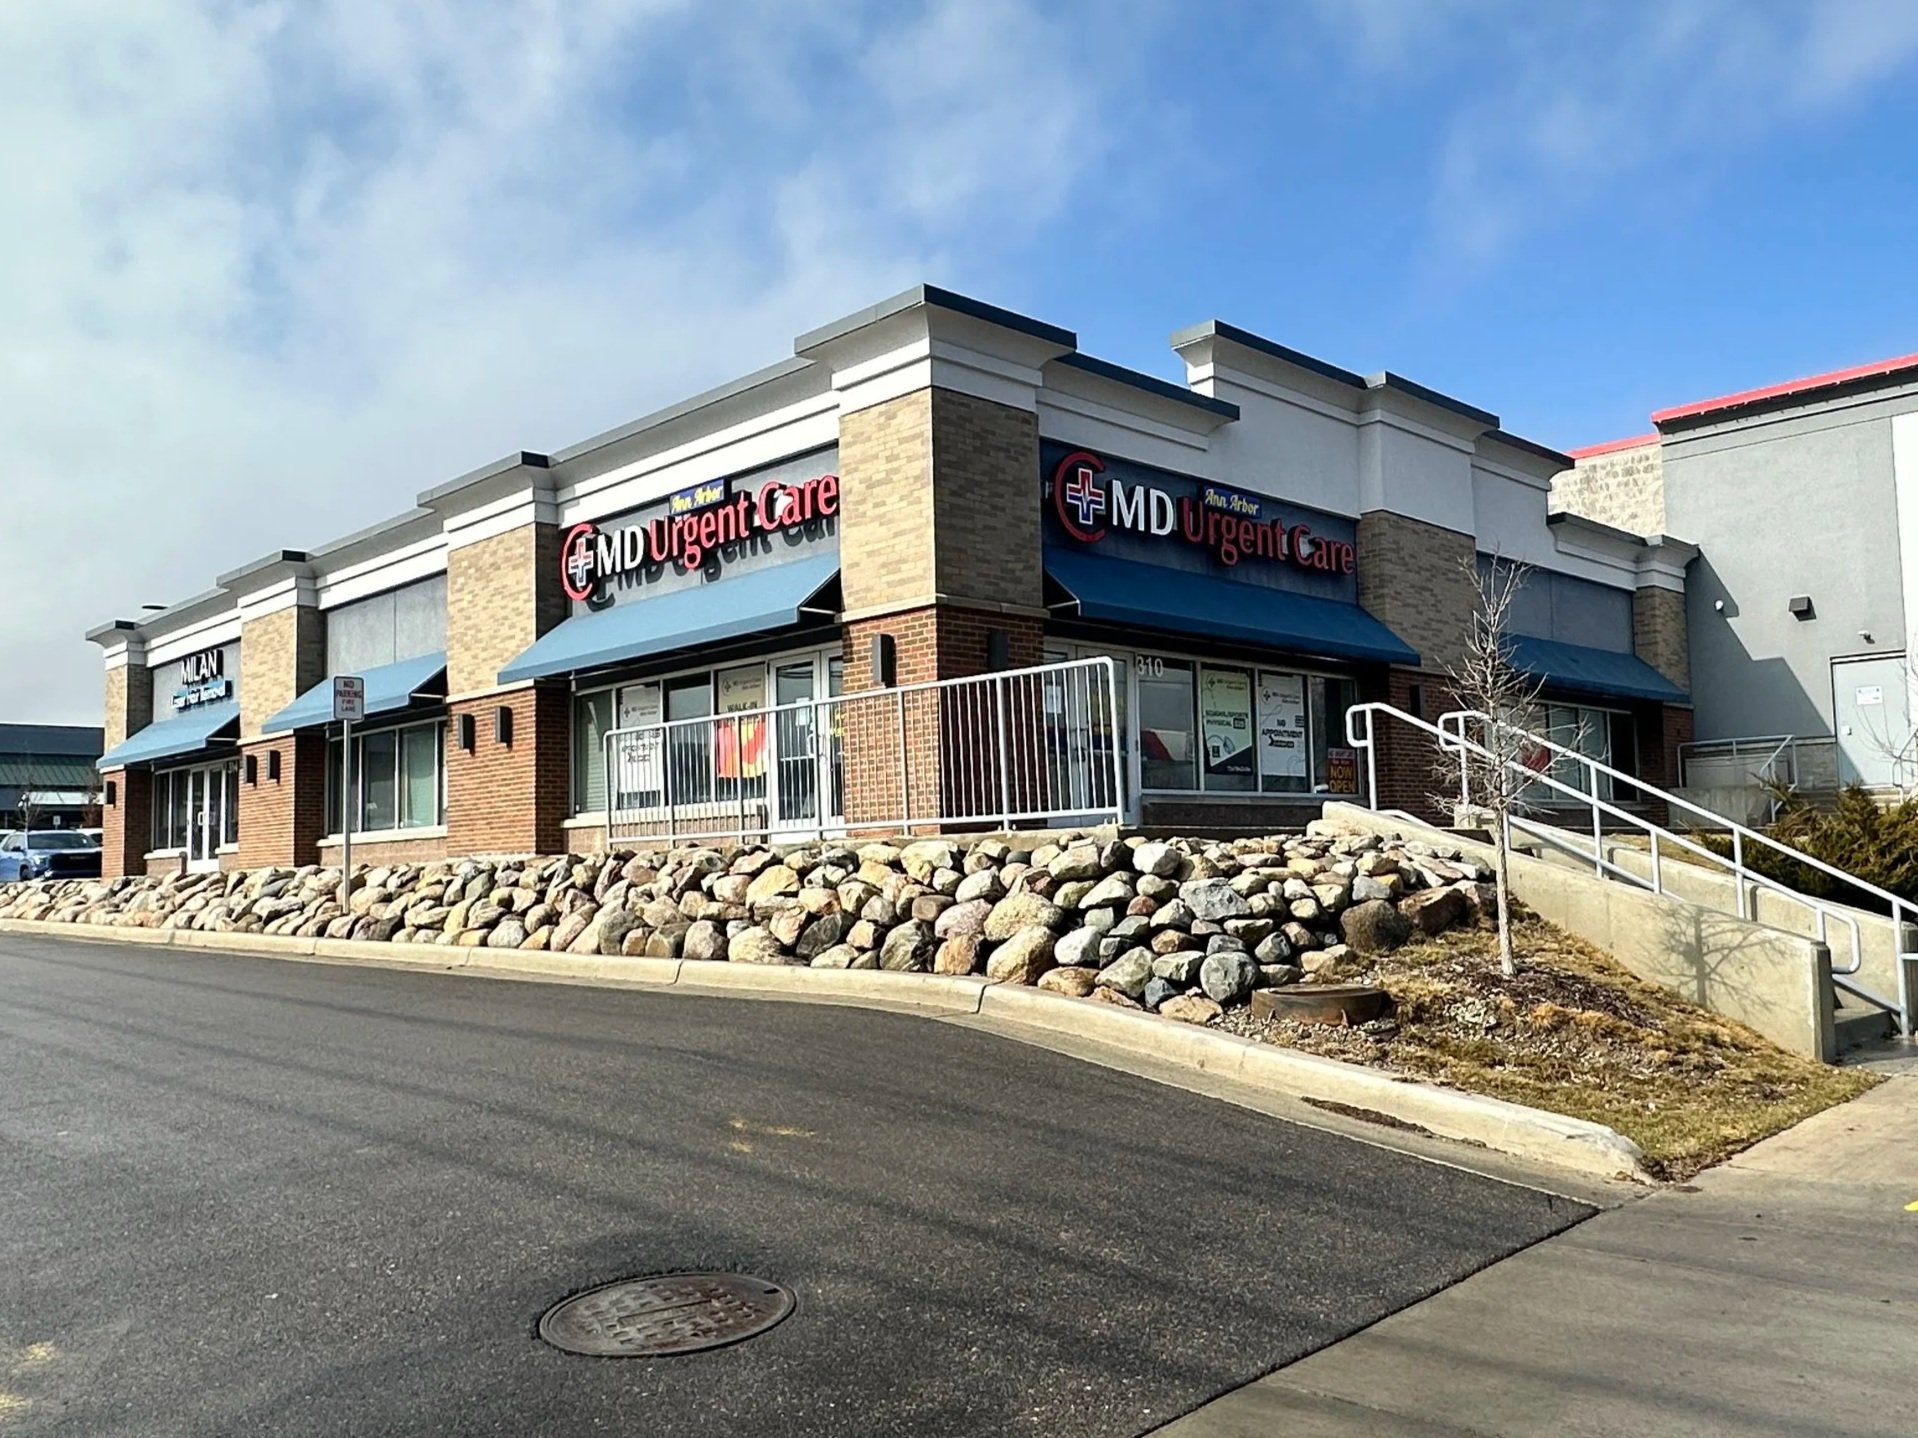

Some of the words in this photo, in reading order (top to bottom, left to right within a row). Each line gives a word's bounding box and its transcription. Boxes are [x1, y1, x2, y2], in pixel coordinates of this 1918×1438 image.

[671, 494, 692, 514] Ann
[693, 485, 725, 508] Arbor
[1205, 489, 1228, 508] Ann
[1229, 494, 1259, 516] Arbor
[597, 525, 644, 577] MD
[650, 490, 749, 570] Urgent
[758, 475, 840, 531] Care
[1112, 479, 1174, 536] MD
[1183, 496, 1286, 566] Urgent
[1294, 524, 1355, 574] Care
[181, 649, 217, 684] MILAN
[1136, 656, 1163, 677] 310
[336, 689, 362, 699] PARKING
[343, 680, 355, 689] NO
[726, 700, 758, 712] WALK-IN
[1330, 765, 1353, 779] NOW
[1330, 780, 1356, 793] OPEN
